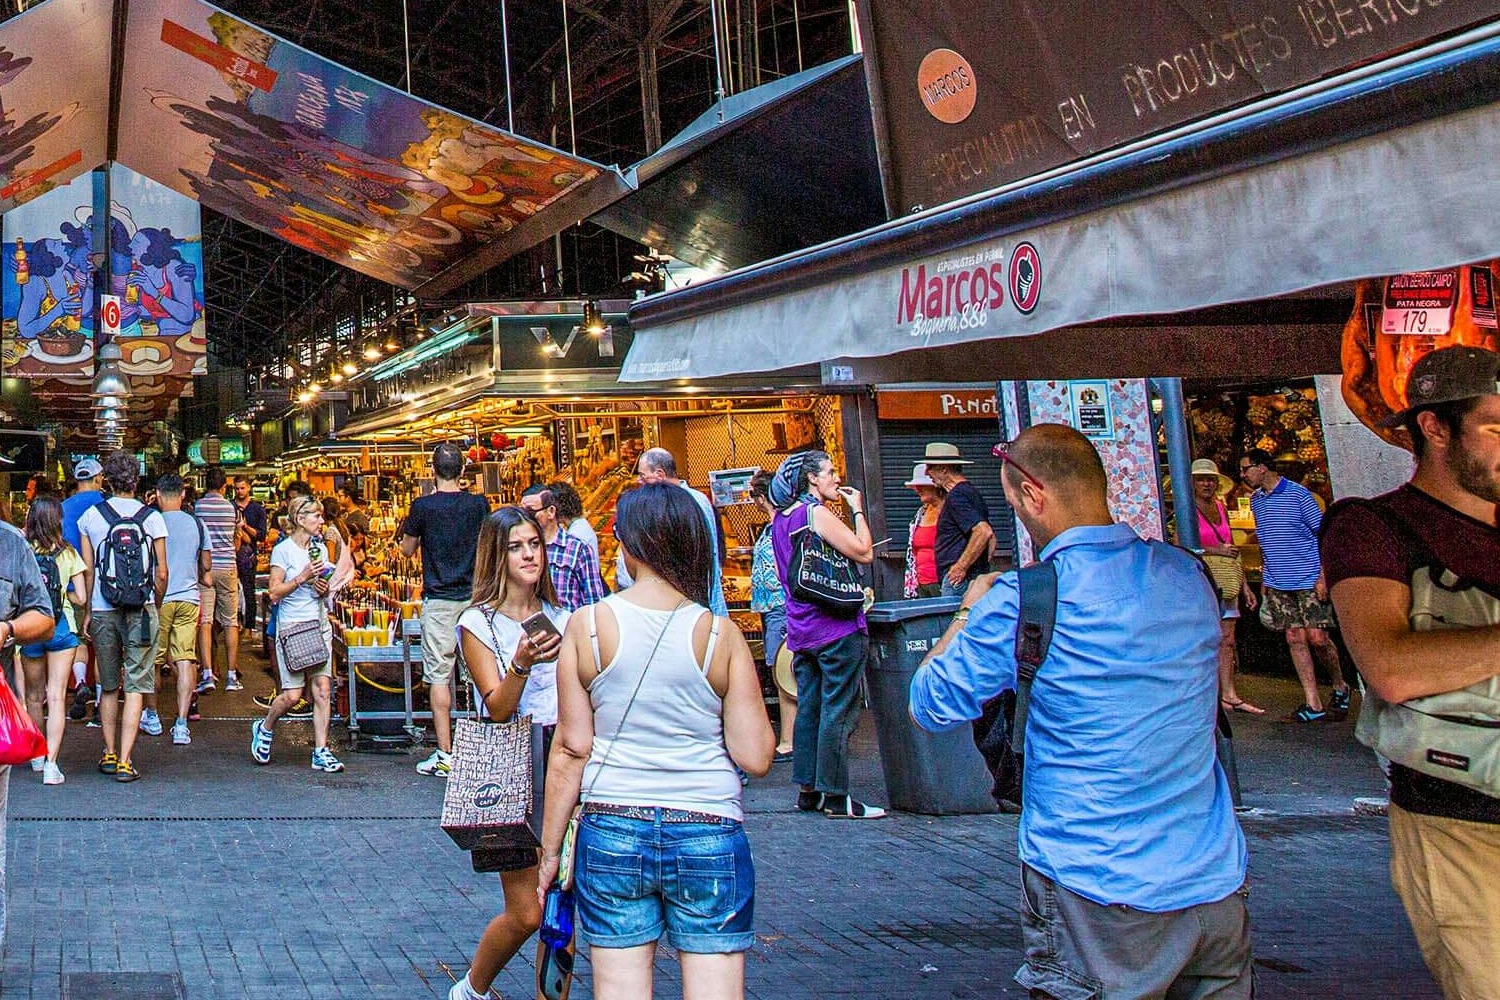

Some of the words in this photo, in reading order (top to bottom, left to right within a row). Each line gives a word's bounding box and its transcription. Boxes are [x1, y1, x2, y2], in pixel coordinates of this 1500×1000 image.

[923, 66, 971, 105] MARCOS
[1058, 94, 1095, 140] EN
[1122, 17, 1291, 117] PRODUCTES
[897, 263, 1004, 325] Marcos
[109, 306, 116, 324] 6
[1403, 310, 1428, 332] 179
[802, 570, 864, 593] BARCELONA
[460, 784, 487, 799] Hard
